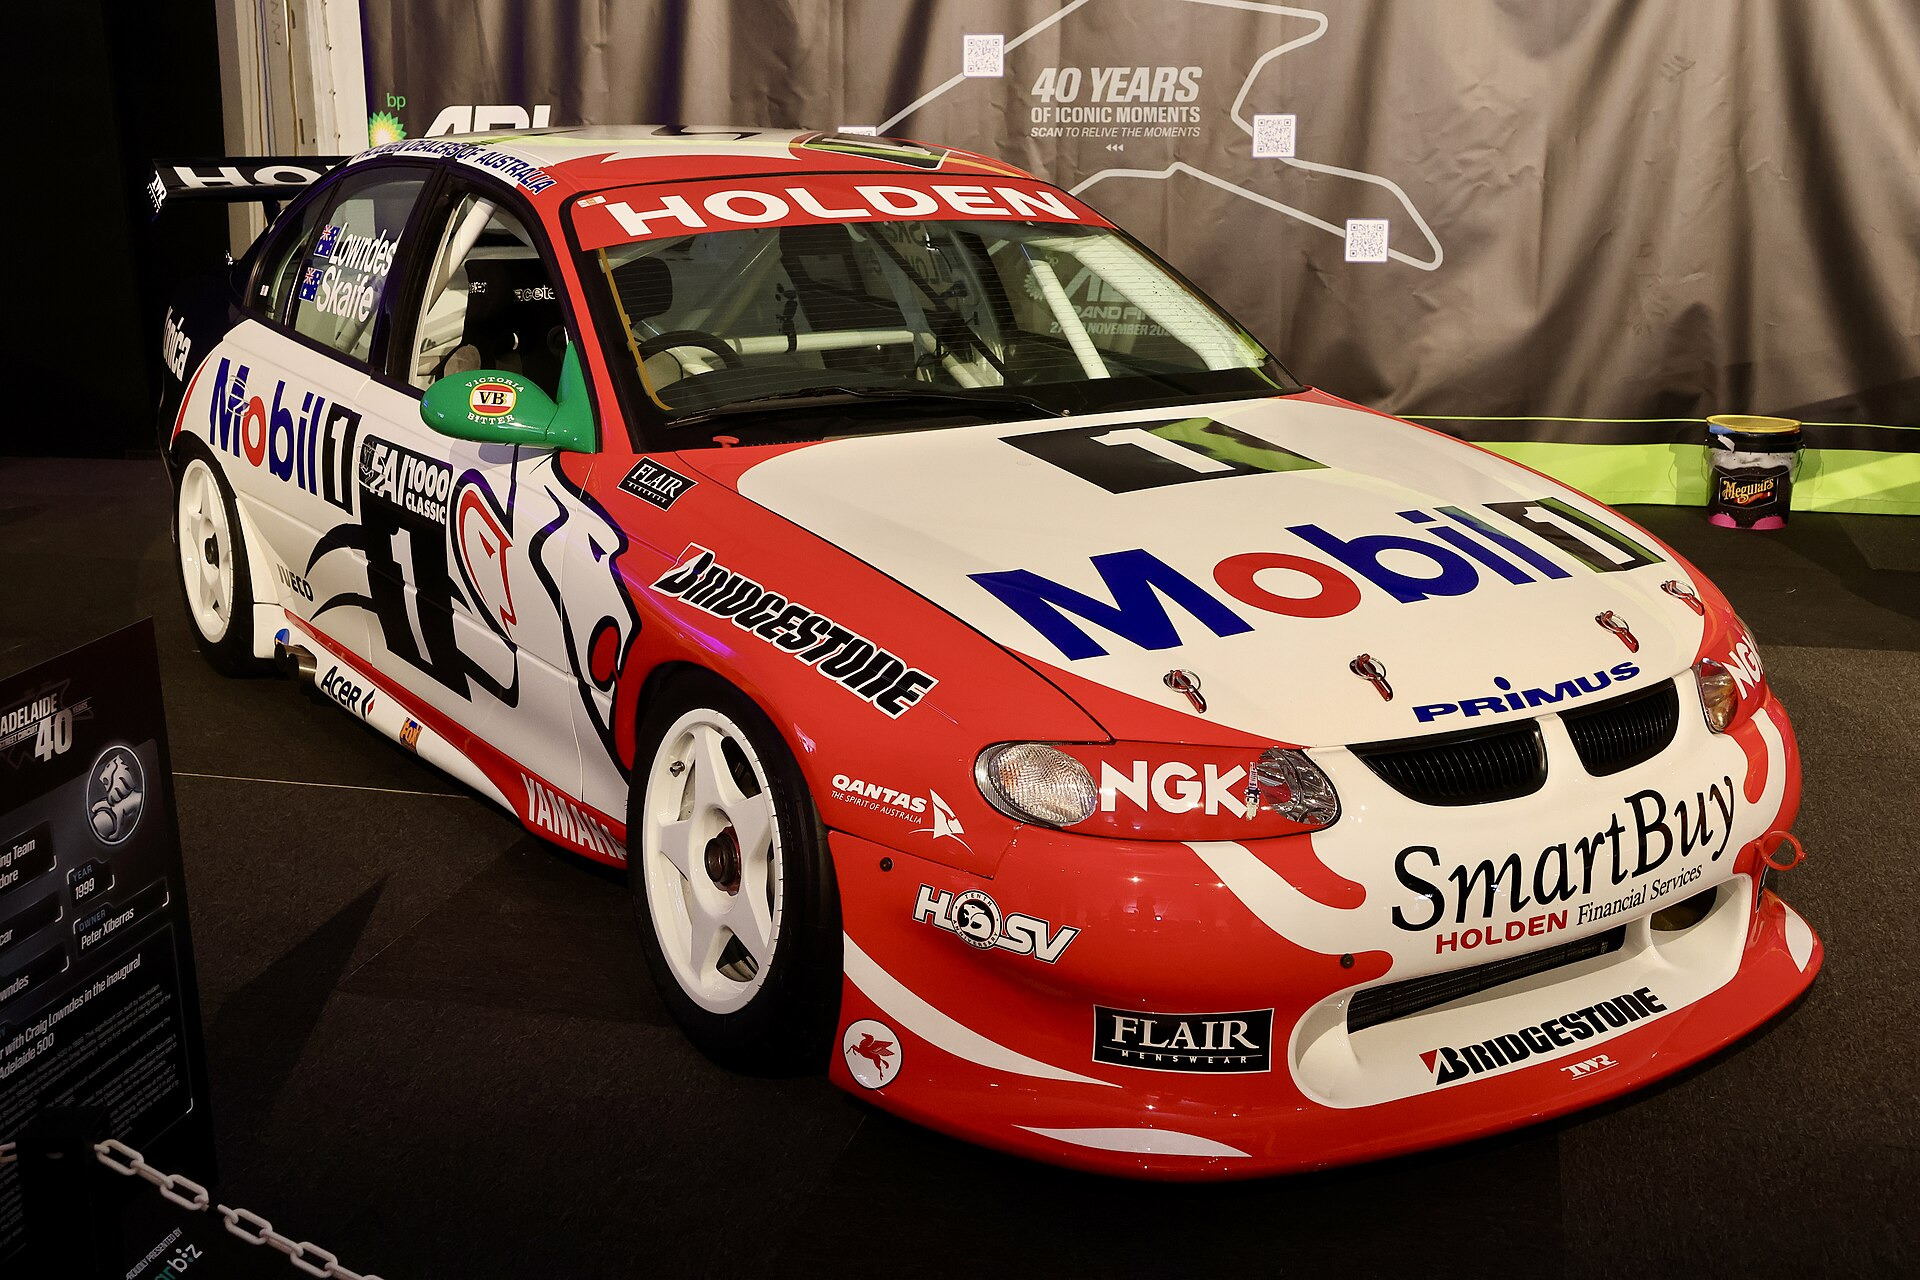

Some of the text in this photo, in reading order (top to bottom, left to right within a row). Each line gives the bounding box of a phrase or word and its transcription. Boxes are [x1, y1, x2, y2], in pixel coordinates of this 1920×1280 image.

[387, 93, 406, 111] bp
[1031, 66, 1203, 103] 40 YEARS
[1031, 107, 1201, 123] OF ICONIC MOMENTS
[1031, 127, 1201, 137] SCAN TO RELIVE THE MOMENTS
[404, 140, 464, 159] DEALERS
[456, 143, 482, 161] OF
[474, 151, 558, 195] AUSTRALIA
[604, 184, 1079, 237] HOLDEN
[329, 222, 398, 277] Lowndes
[316, 265, 374, 323] Skaife
[465, 376, 525, 393] VICTORIA
[479, 391, 508, 405] VB
[209, 356, 326, 497] Mobil
[467, 412, 515, 425] BITTER
[1086, 427, 1238, 474] 1
[631, 463, 684, 498] FLAIR
[405, 491, 446, 525] CLASSIC
[276, 562, 315, 602] IVECO
[965, 506, 1573, 661] Mobil
[653, 548, 938, 719] BRIDGESTONE
[0, 692, 58, 737] ADELAIDE
[35, 709, 73, 762] 40
[831, 790, 922, 825] THE SPIRIT OF AUSTRALIA
[832, 774, 928, 813] QANTAS
[1101, 760, 1248, 819] NGK
[13, 839, 36, 860] Team
[1391, 775, 1735, 932] SmartBuy
[72, 864, 93, 882] YEAR
[75, 877, 95, 900] 1999
[1576, 863, 1703, 926] Financial Services
[79, 909, 107, 932] OWNER
[81, 908, 135, 950] Peter Xiberras
[1435, 910, 1568, 955] HOLDEN
[5, 1033, 25, 1057] with
[25, 1019, 48, 1042] Craig
[48, 994, 84, 1027] Lowndes
[84, 989, 93, 1003] in
[92, 981, 106, 997] the
[106, 953, 141, 988] inaugural
[36, 1032, 55, 1056] 500
[1111, 1014, 1260, 1051] FLAIR
[1434, 986, 1668, 1086] BRIDGESTONE
[1121, 1050, 1248, 1064] MENSWEAR
[145, 1232, 177, 1263] PRESENTED
[172, 1226, 183, 1238] BY
